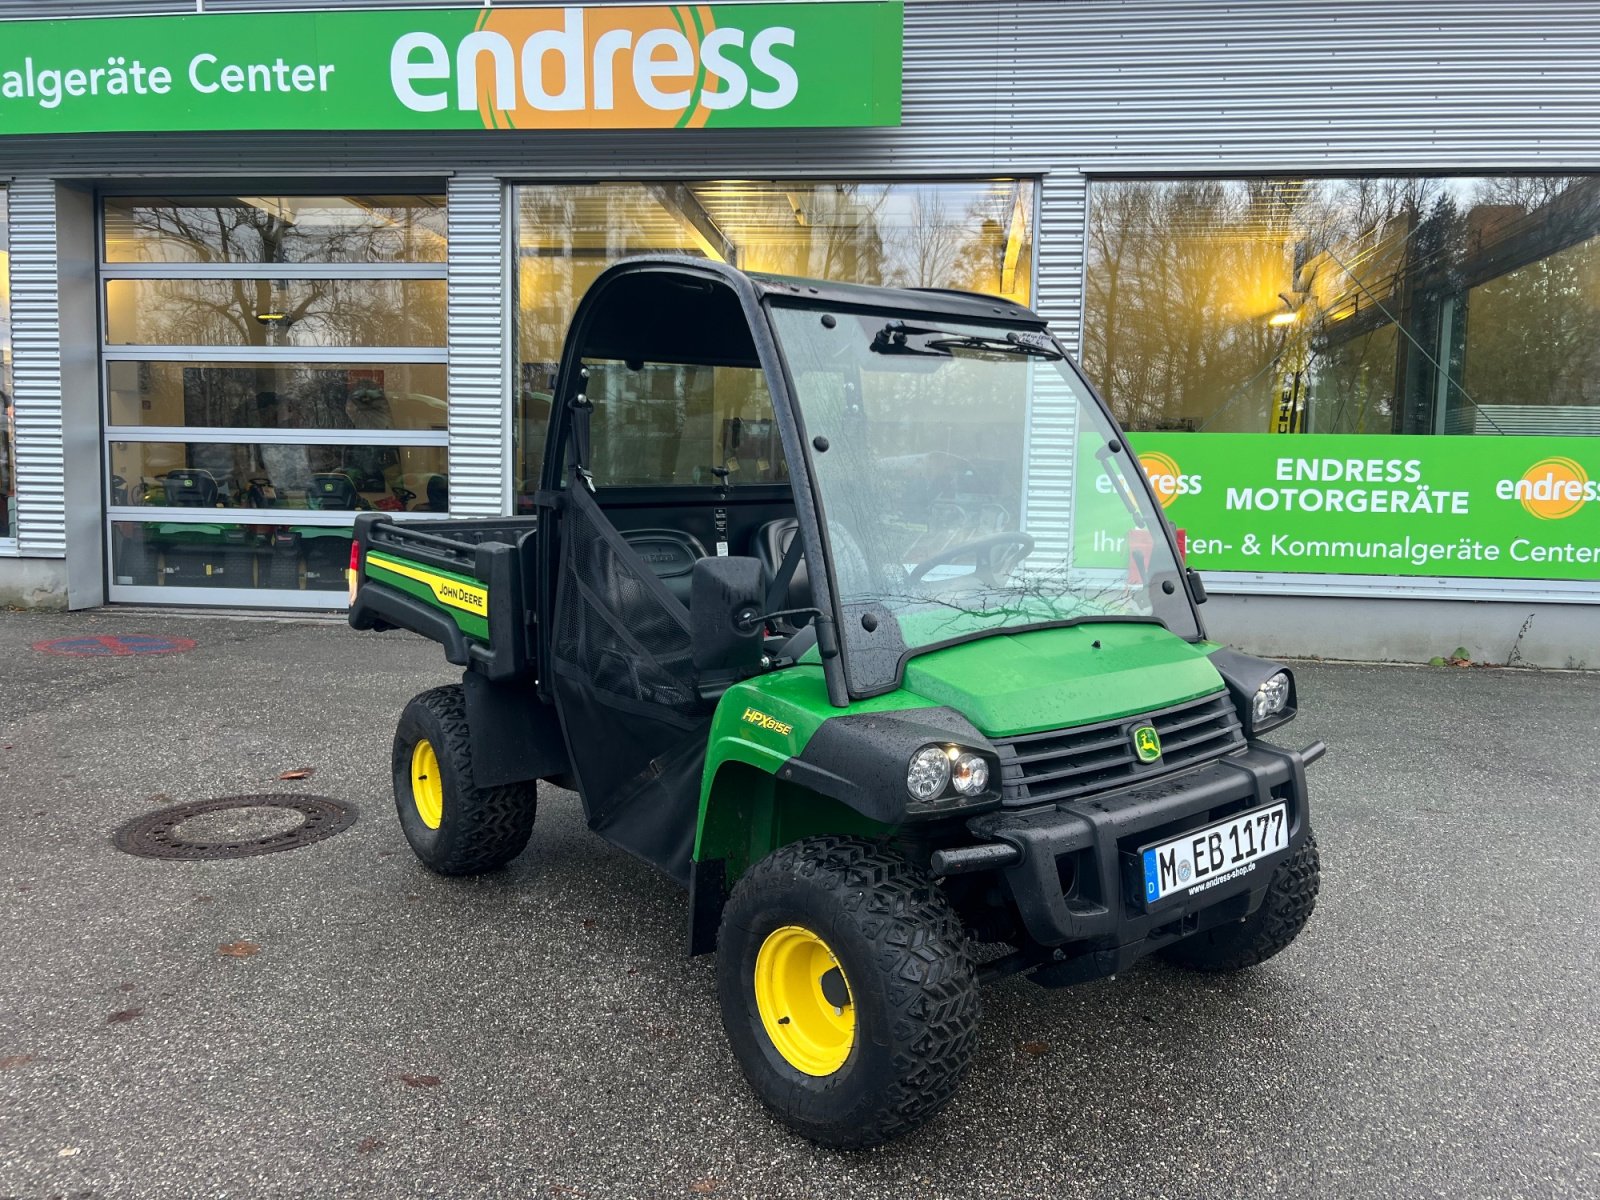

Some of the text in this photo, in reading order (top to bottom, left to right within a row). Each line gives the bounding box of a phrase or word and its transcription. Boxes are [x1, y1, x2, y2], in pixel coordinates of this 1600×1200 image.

[390, 7, 799, 112] endress
[1, 53, 335, 108] algeräte Center
[1276, 458, 1421, 483] ENDRESS
[1226, 485, 1469, 514] MOTORGERÄTE
[1495, 472, 1600, 502] endres
[1093, 530, 1125, 552] Ihr
[1184, 534, 1232, 554] ten-
[1241, 533, 1261, 555] &
[1271, 533, 1500, 565] Kommunalgeräte
[439, 583, 483, 608] JOHN DEERE
[1159, 808, 1284, 892] M EB 1177
[1148, 881, 1155, 894] D
[1188, 863, 1256, 896] www.endress-shop.de
